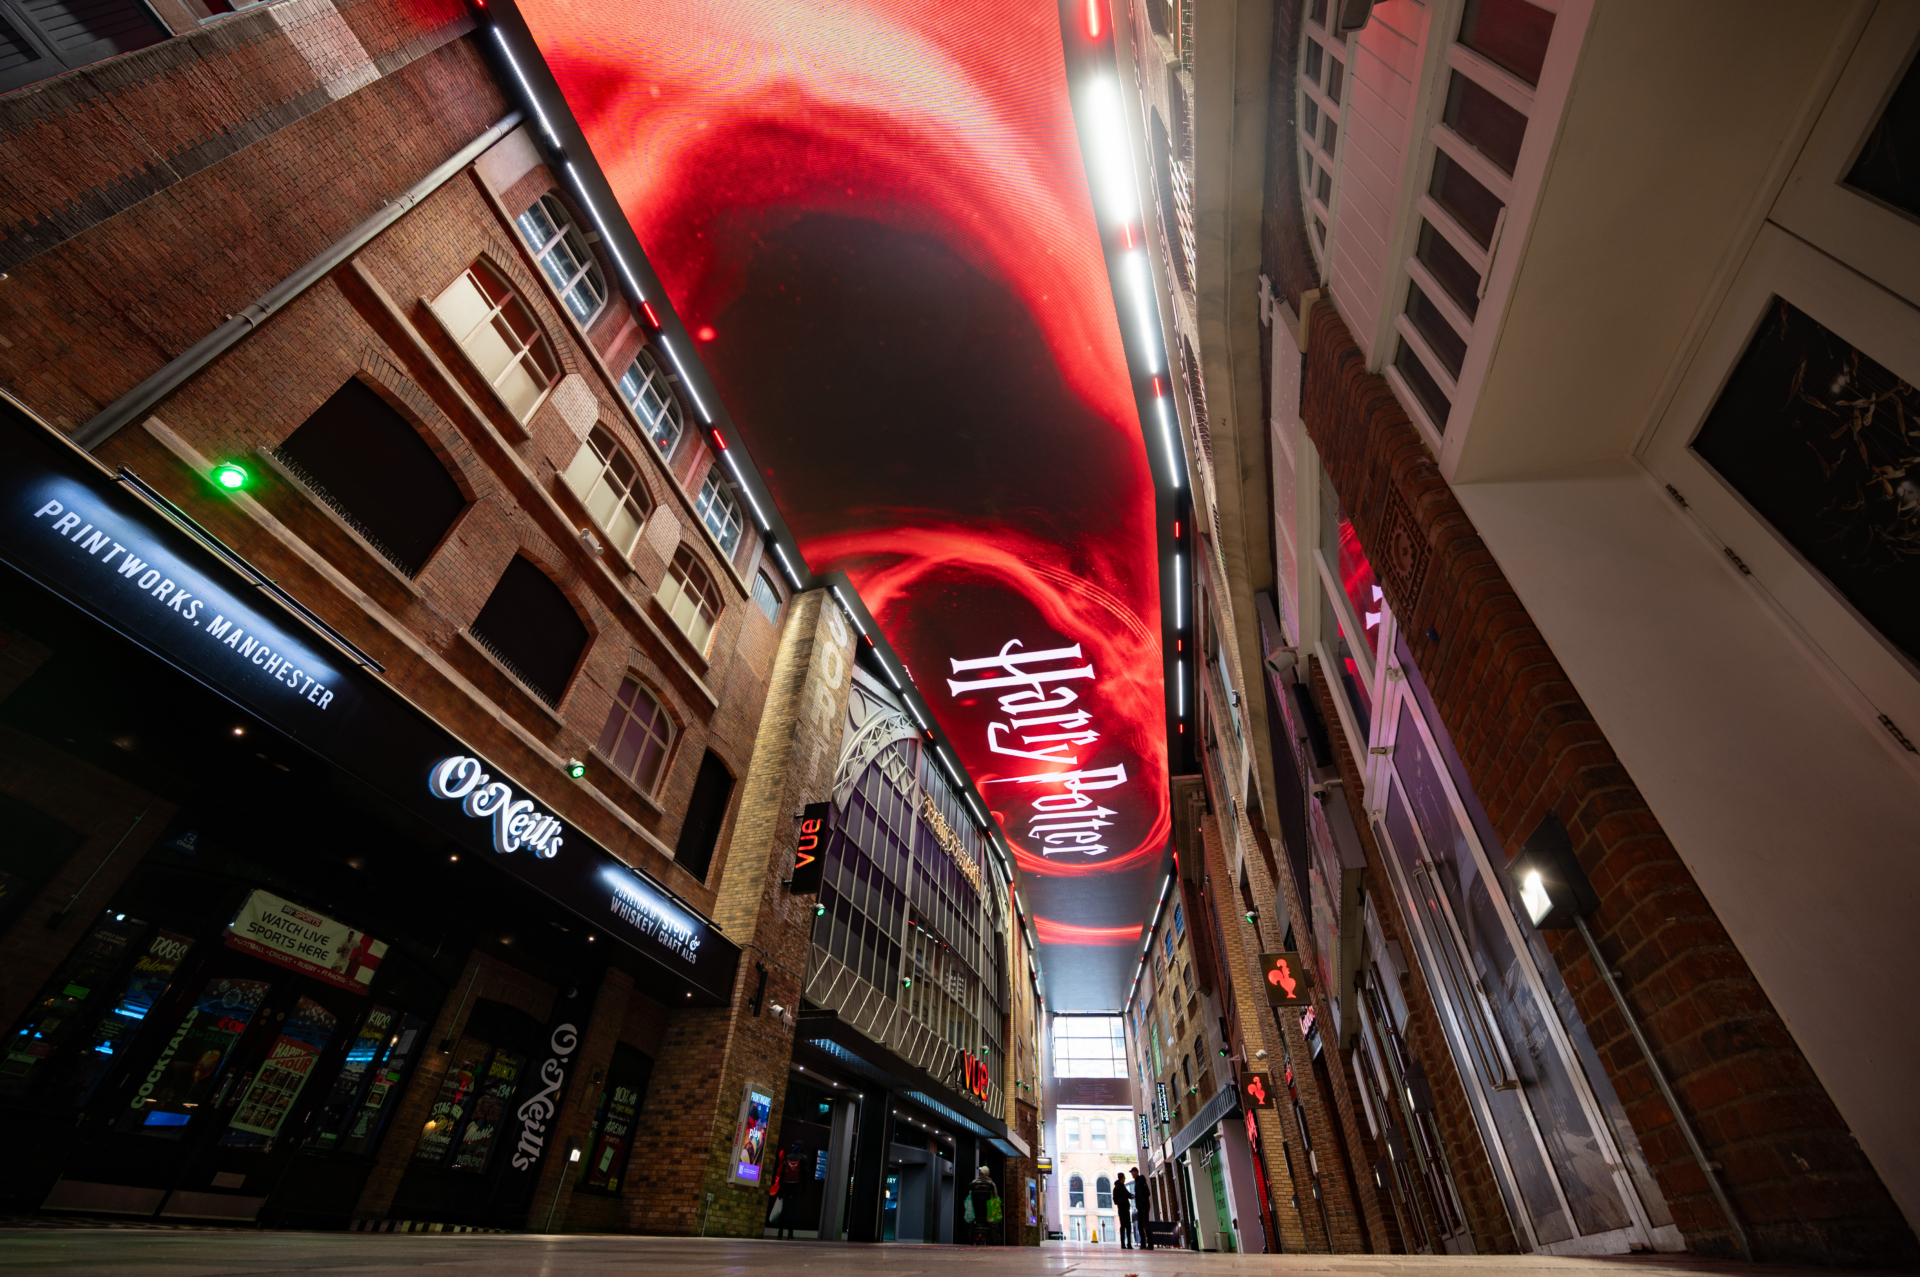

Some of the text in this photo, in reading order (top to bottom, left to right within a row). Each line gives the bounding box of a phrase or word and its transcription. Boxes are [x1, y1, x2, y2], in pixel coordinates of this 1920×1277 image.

[33, 498, 338, 711] PRINTWORKS, MANCHESTER
[946, 638, 1128, 858] Harry Potter
[428, 754, 564, 860] O'Neill's
[614, 881, 659, 921] PURVEYORS OF
[282, 905, 322, 927] sky SPORTS
[610, 896, 654, 936] WHISKEY
[99, 930, 127, 942] LOVELY GAME
[261, 911, 330, 946] WATCH LIVE
[662, 914, 692, 945] STOUT
[106, 936, 127, 947] GUINNESS
[149, 935, 188, 961] DOGS
[246, 921, 330, 961] SPORTS HERE
[658, 930, 697, 964] CRAFT ALES
[134, 955, 176, 975] Welcome
[233, 937, 265, 954] FOOTBALL
[268, 950, 293, 964] CRICKET
[297, 960, 318, 972] RUGBY
[328, 971, 346, 983] RACING
[368, 1010, 391, 1029] KIDS
[187, 1029, 195, 1039] 2
[194, 1031, 205, 1039] for
[358, 1026, 384, 1042] Welcome
[130, 1008, 199, 1109] COCKTAILS
[271, 1042, 307, 1059] HAPPY
[454, 1039, 489, 1065] QUIZ
[274, 1056, 314, 1075] HOUR
[488, 1061, 517, 1082] BRUNCH
[511, 1023, 578, 1173] O'Neill's
[613, 1085, 631, 1104] 10%
[431, 1101, 452, 1116] STAG
[472, 1100, 503, 1123] LIVE
[423, 1130, 452, 1145] Welcome
[462, 1120, 495, 1145] Music
[604, 1120, 627, 1137] ARENA
[455, 1154, 484, 1168] WEEKEND
